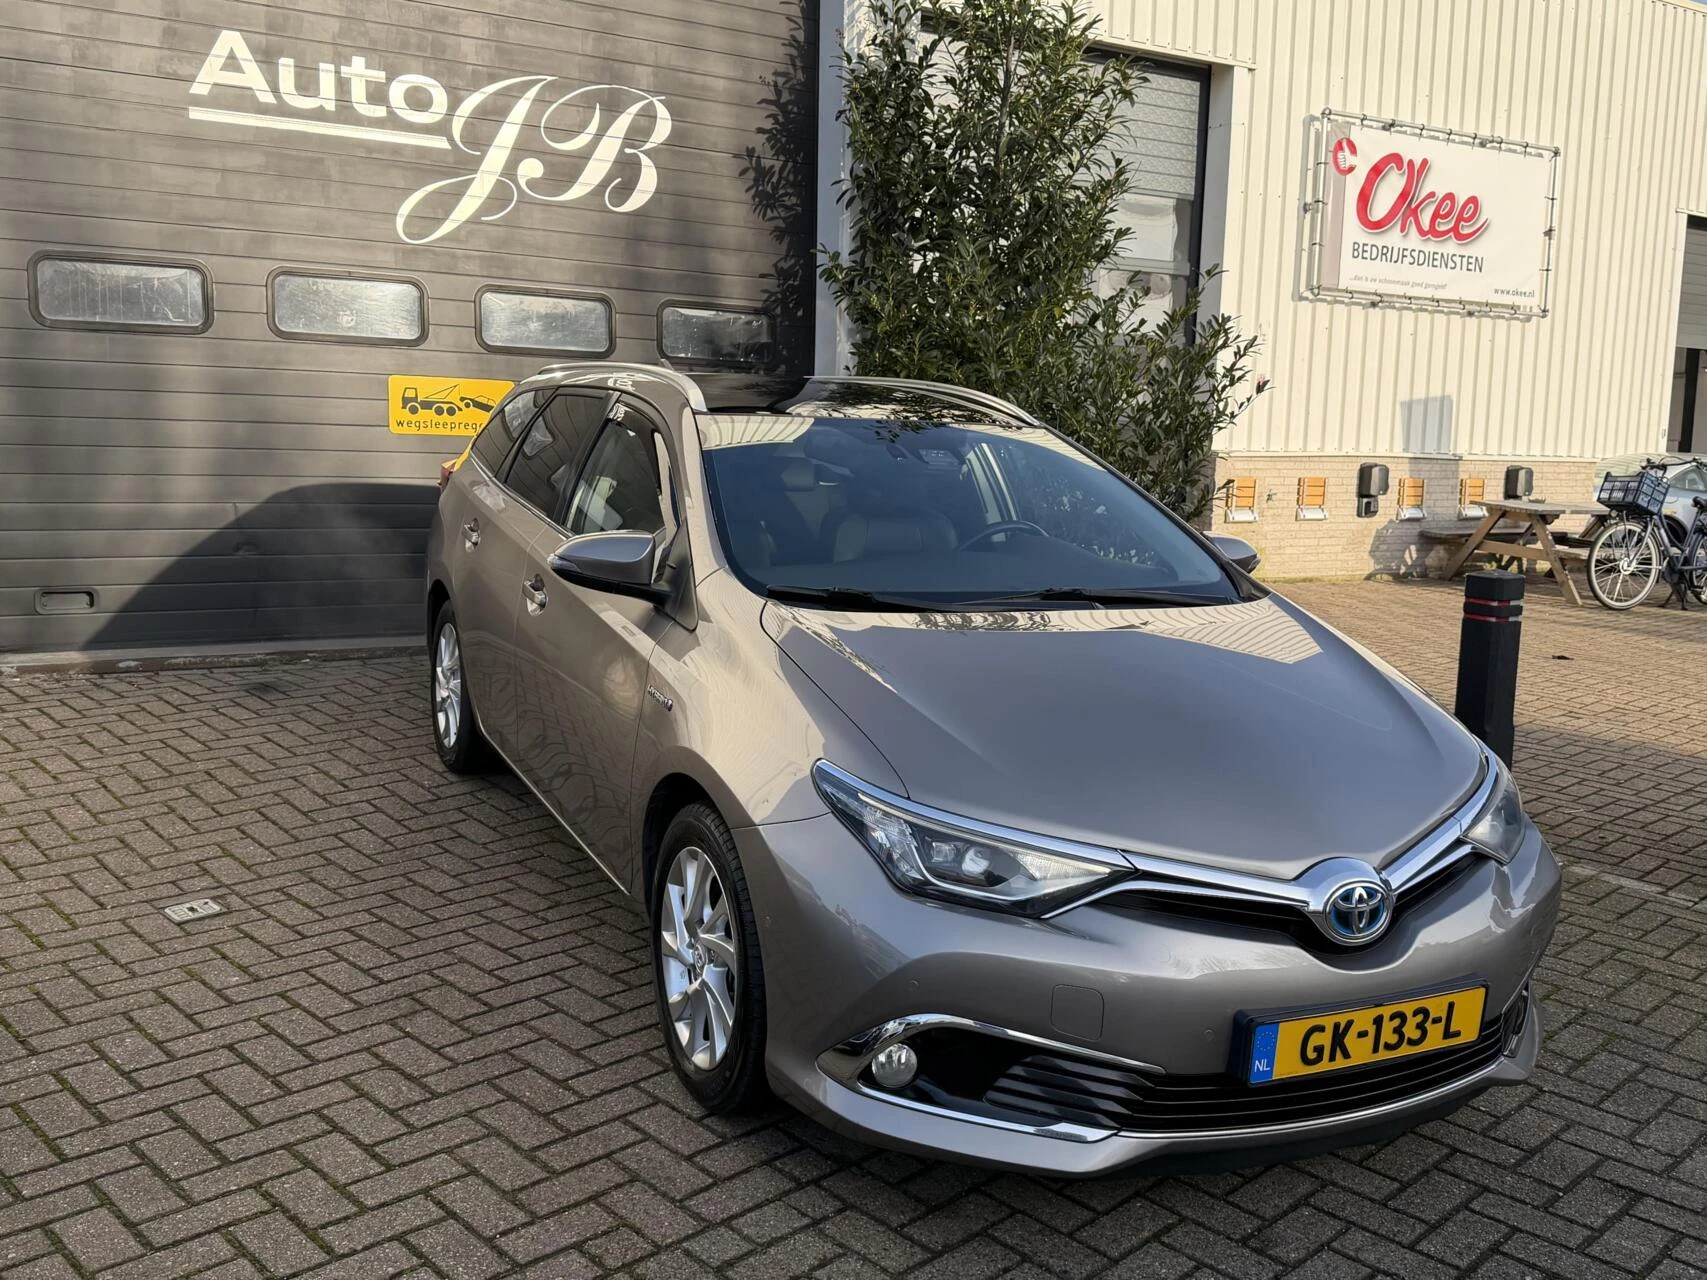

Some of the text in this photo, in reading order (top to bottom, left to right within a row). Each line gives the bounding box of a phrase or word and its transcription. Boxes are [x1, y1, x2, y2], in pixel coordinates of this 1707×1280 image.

[189, 30, 672, 244] Auto JB
[1352, 241, 1484, 273] BEDRIJFSDIENSTEN
[1494, 287, 1535, 299] www.okee.nl
[1300, 1001, 1462, 1066] GK-133-L
[1254, 1058, 1271, 1073] NL
